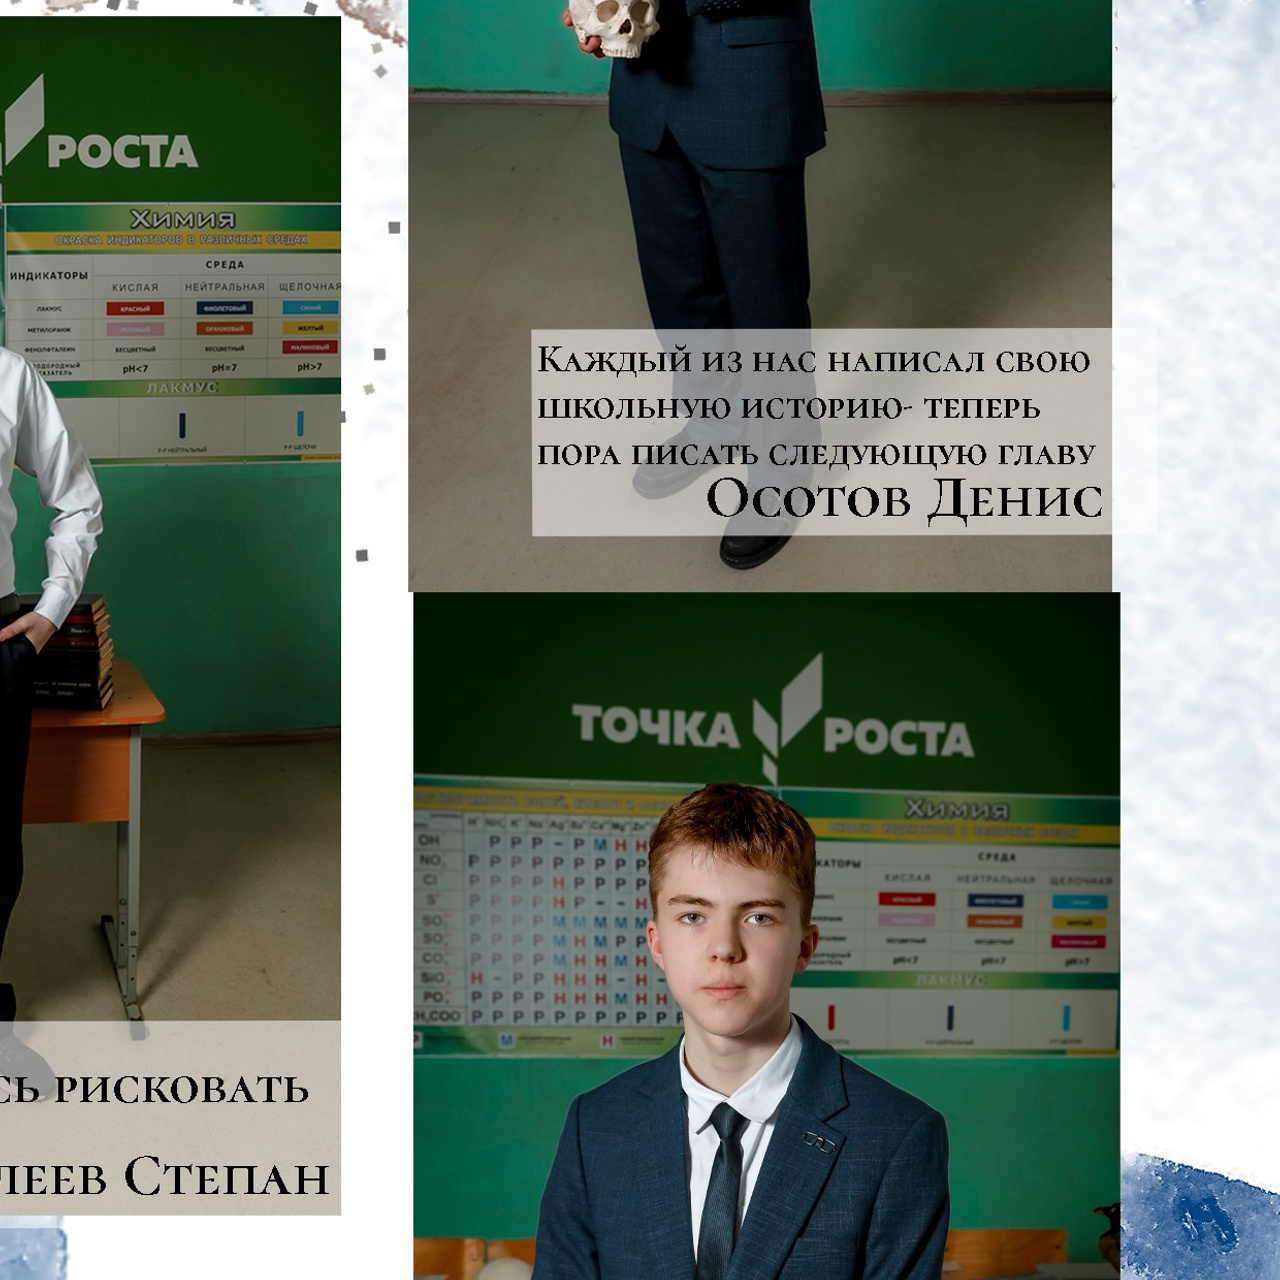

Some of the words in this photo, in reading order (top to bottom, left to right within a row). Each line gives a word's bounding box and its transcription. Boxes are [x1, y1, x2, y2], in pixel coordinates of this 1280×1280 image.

[48, 134, 198, 169] РОСТА
[129, 209, 236, 229] Химия
[55, 235, 102, 246] ОКРАСКА
[107, 235, 183, 246] ИНДИКАТОРОВ
[200, 234, 263, 246] РАЗЛИЧНЫХ
[267, 234, 307, 245] СРЕДАХ
[205, 259, 245, 269] СРЕДА
[10, 271, 88, 281] ИНДИКАТОРЫ
[112, 282, 159, 292] КИСЛАЯ
[185, 281, 265, 292] НЕЙТРАЛЬНАЯ
[279, 282, 341, 293] ЩЕЛОЧНАЯ
[120, 304, 151, 313] КРАСНЫЙ
[203, 304, 246, 313] ФИОЛЕТОВЫЙ
[205, 324, 244, 333] ОРАНЖЕВЫЙ
[115, 345, 156, 354] БЕСЦВЕТНЫЙ
[205, 344, 245, 353] БЕСЦВЕТНЫЙ
[122, 364, 148, 374] pH<7
[212, 363, 237, 374] pH=7
[297, 362, 322, 373] pH>7
[146, 381, 219, 394] ЛАКМУС
[572, 704, 741, 749] ТОЧКА
[824, 718, 974, 758] РОСТА
[905, 796, 1010, 820] Химия
[978, 852, 1016, 862] СРЕДА
